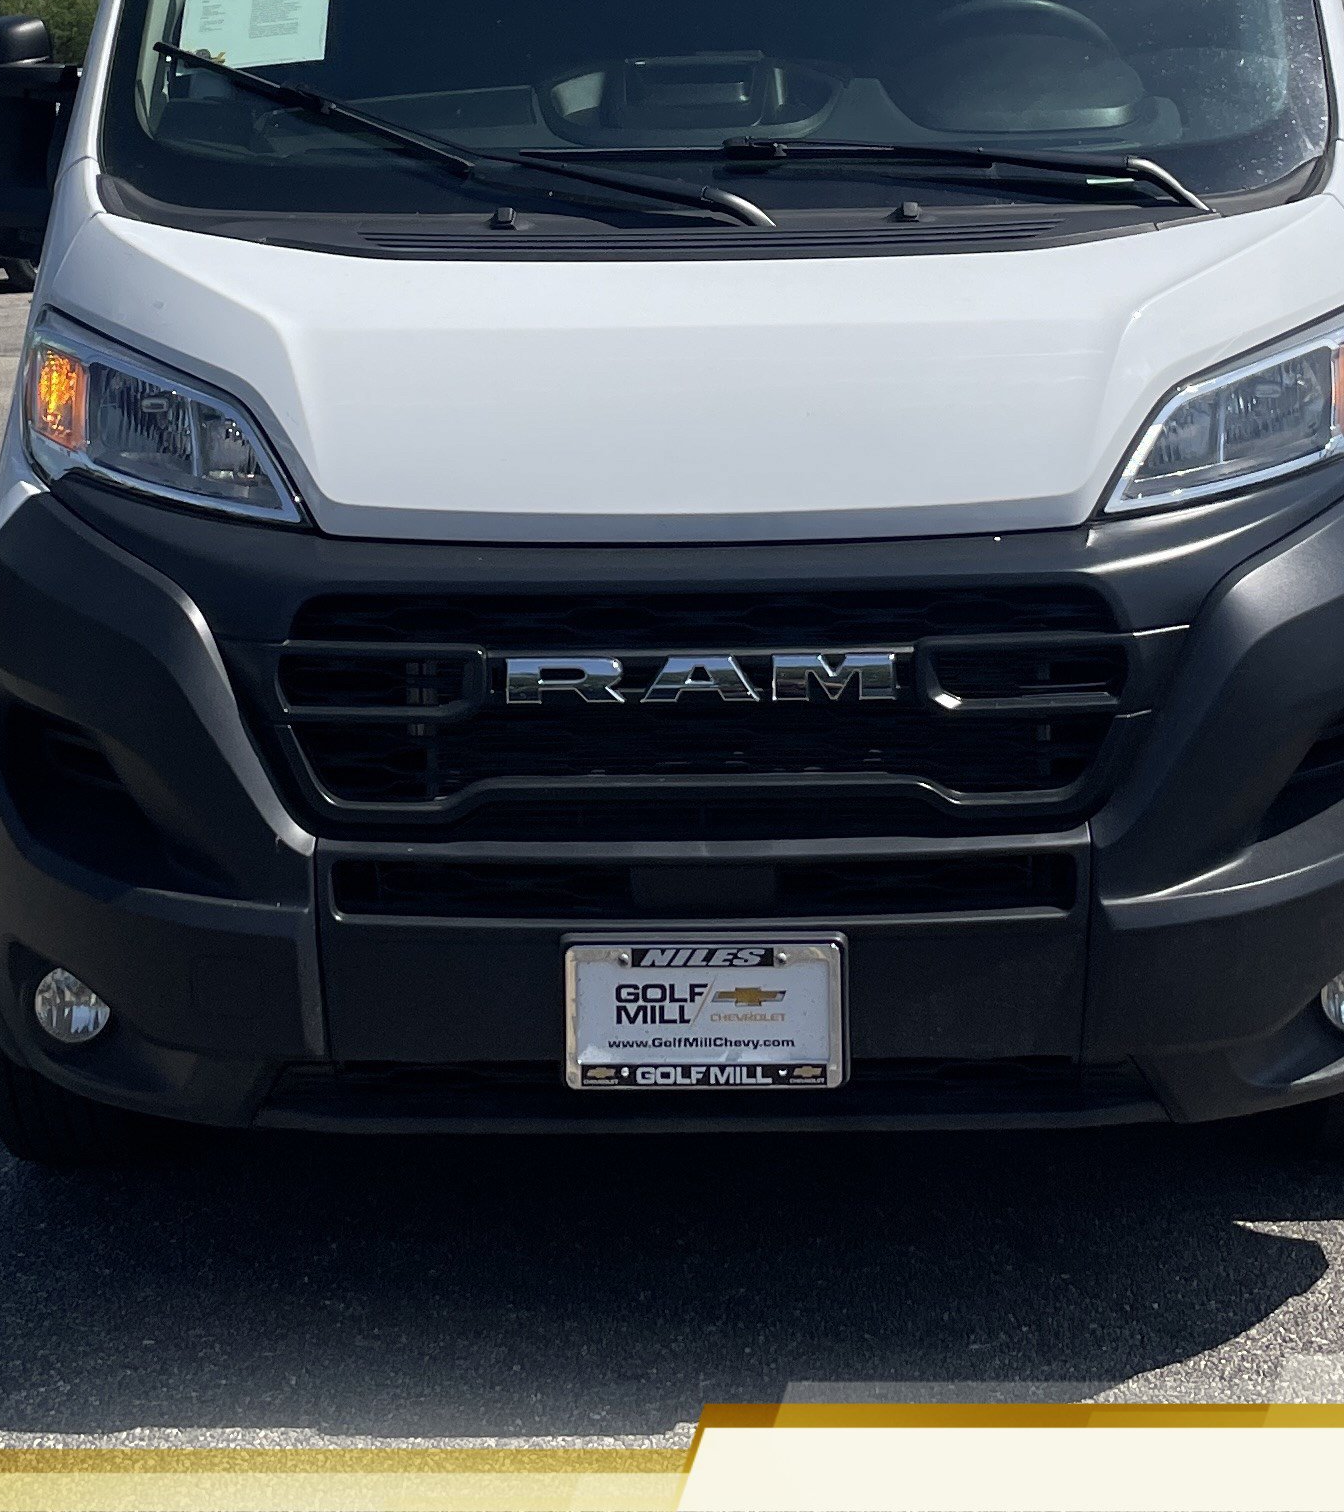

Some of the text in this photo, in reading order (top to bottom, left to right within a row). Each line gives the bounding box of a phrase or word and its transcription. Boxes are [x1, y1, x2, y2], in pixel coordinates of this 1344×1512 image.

[505, 653, 897, 704] RAM
[639, 947, 766, 967] NILES
[614, 983, 708, 1003] GOLF
[615, 1005, 692, 1025] MILL
[709, 1012, 786, 1022] CHEVROLET
[607, 1037, 795, 1049] www.GolfMillChevy.com
[635, 1066, 773, 1084] GOLF MILL
